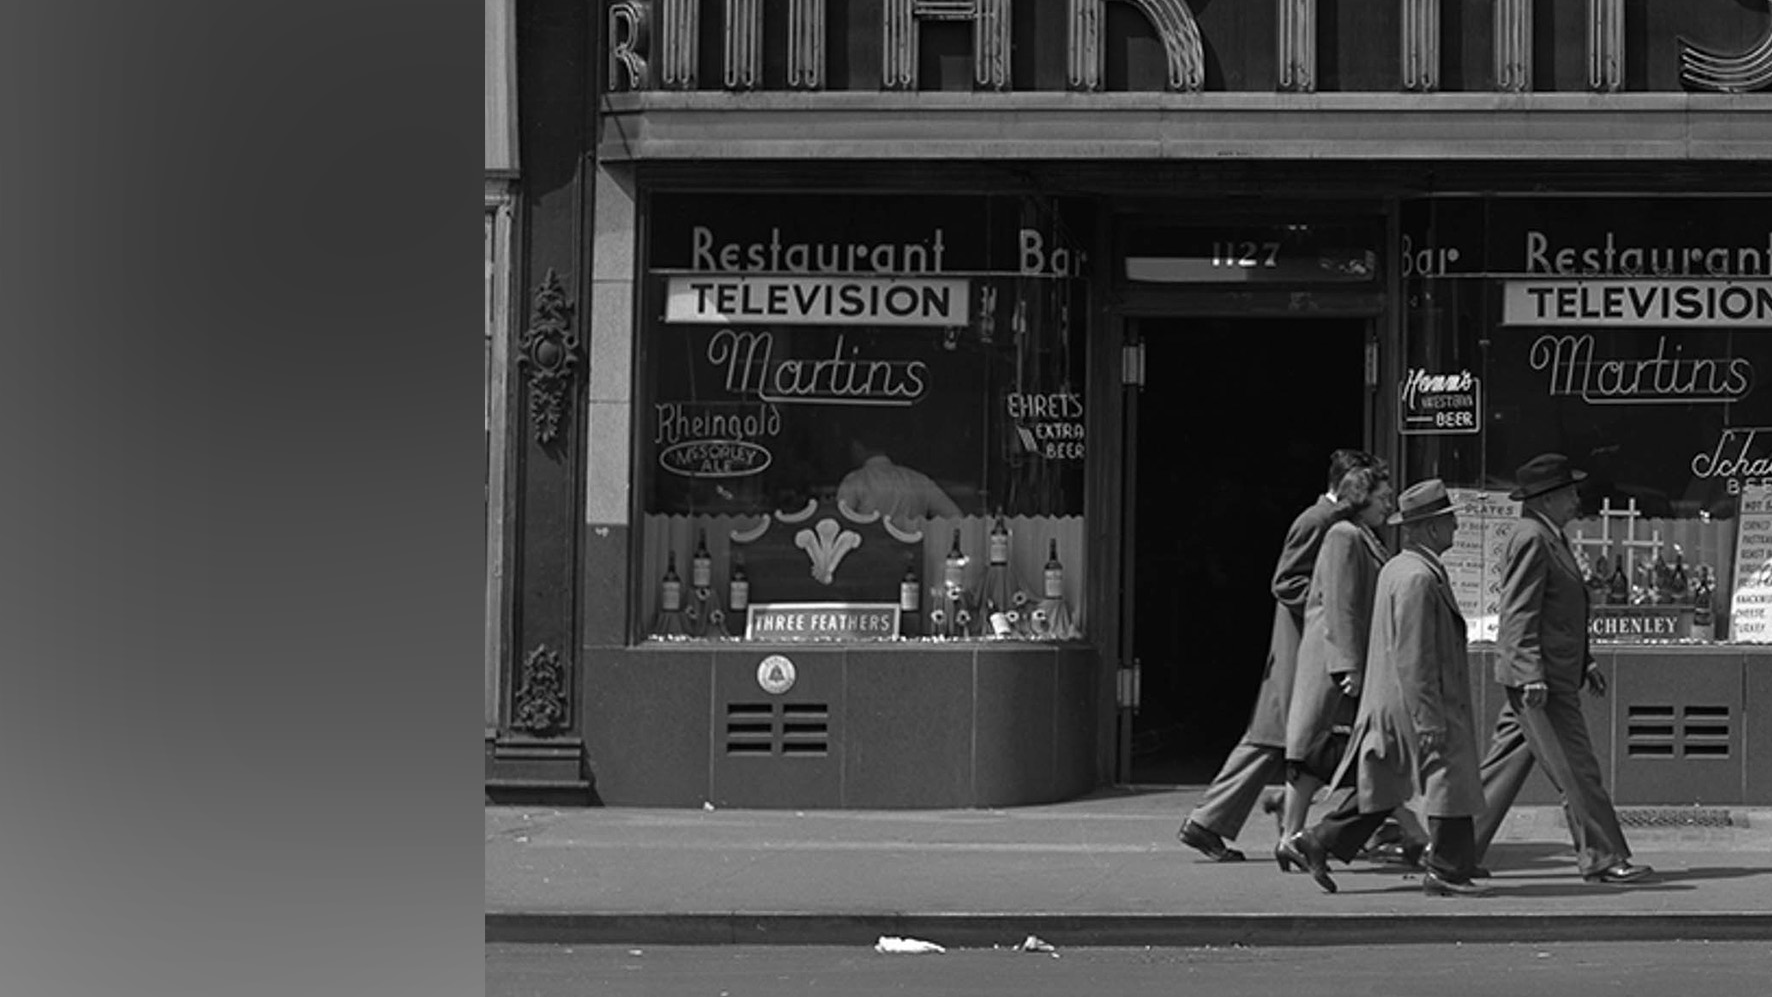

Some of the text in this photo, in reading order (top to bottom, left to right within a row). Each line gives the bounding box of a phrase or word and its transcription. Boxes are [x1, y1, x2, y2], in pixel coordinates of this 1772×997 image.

[692, 225, 1089, 278] Restaurant Bar
[1211, 241, 1281, 267] 1127
[691, 283, 949, 317] TELEVISION
[707, 328, 929, 407] Martins
[1529, 333, 1753, 405] Martins
[654, 402, 781, 444] Rheingold
[1035, 422, 1086, 441] EXTRA
[1435, 410, 1475, 429] BEER
[1046, 441, 1087, 461] BEER
[754, 613, 892, 632] THREE FEATHERS
